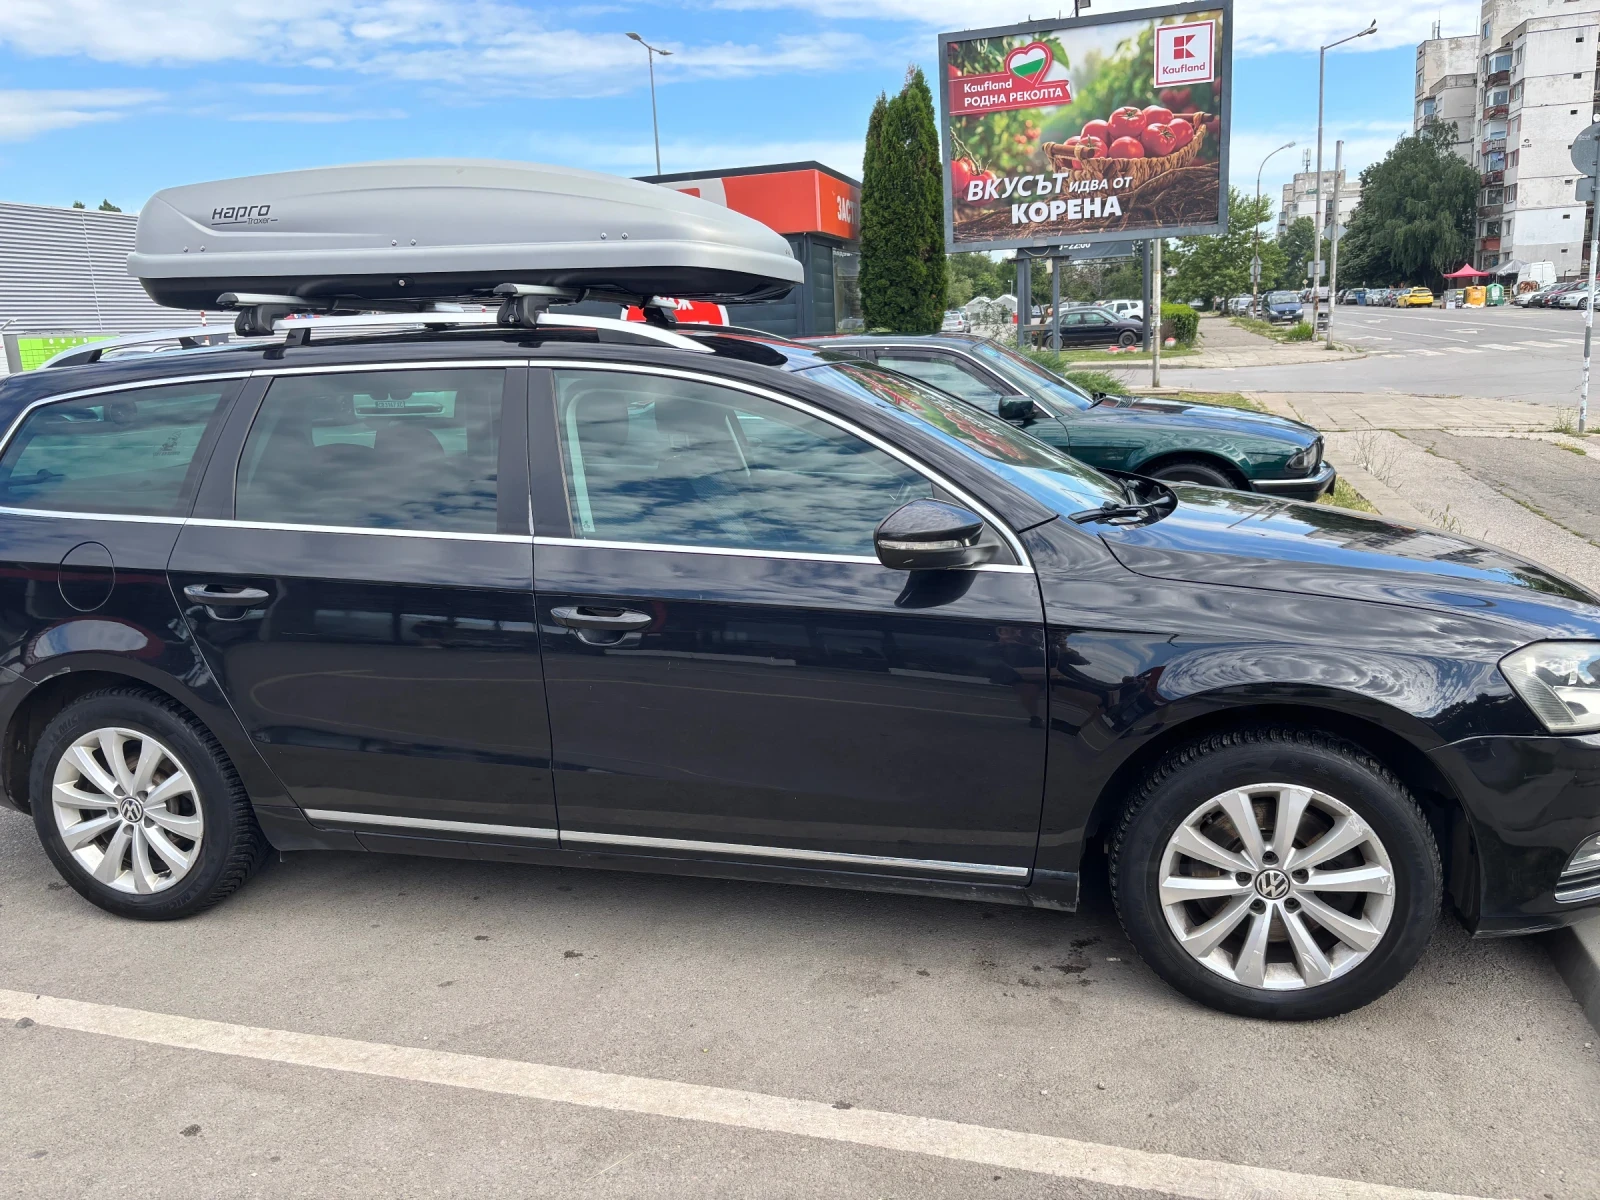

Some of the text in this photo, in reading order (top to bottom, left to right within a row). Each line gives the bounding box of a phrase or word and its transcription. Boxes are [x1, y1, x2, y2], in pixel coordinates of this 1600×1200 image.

[1162, 61, 1206, 75] Kaufland
[963, 78, 1013, 93] Kaufland
[964, 87, 1063, 107] РОДНА РЕКОЛТА
[967, 172, 1133, 202] ВКУСЪТ ИДВА ОТ
[1011, 195, 1123, 225] КОРЕНА
